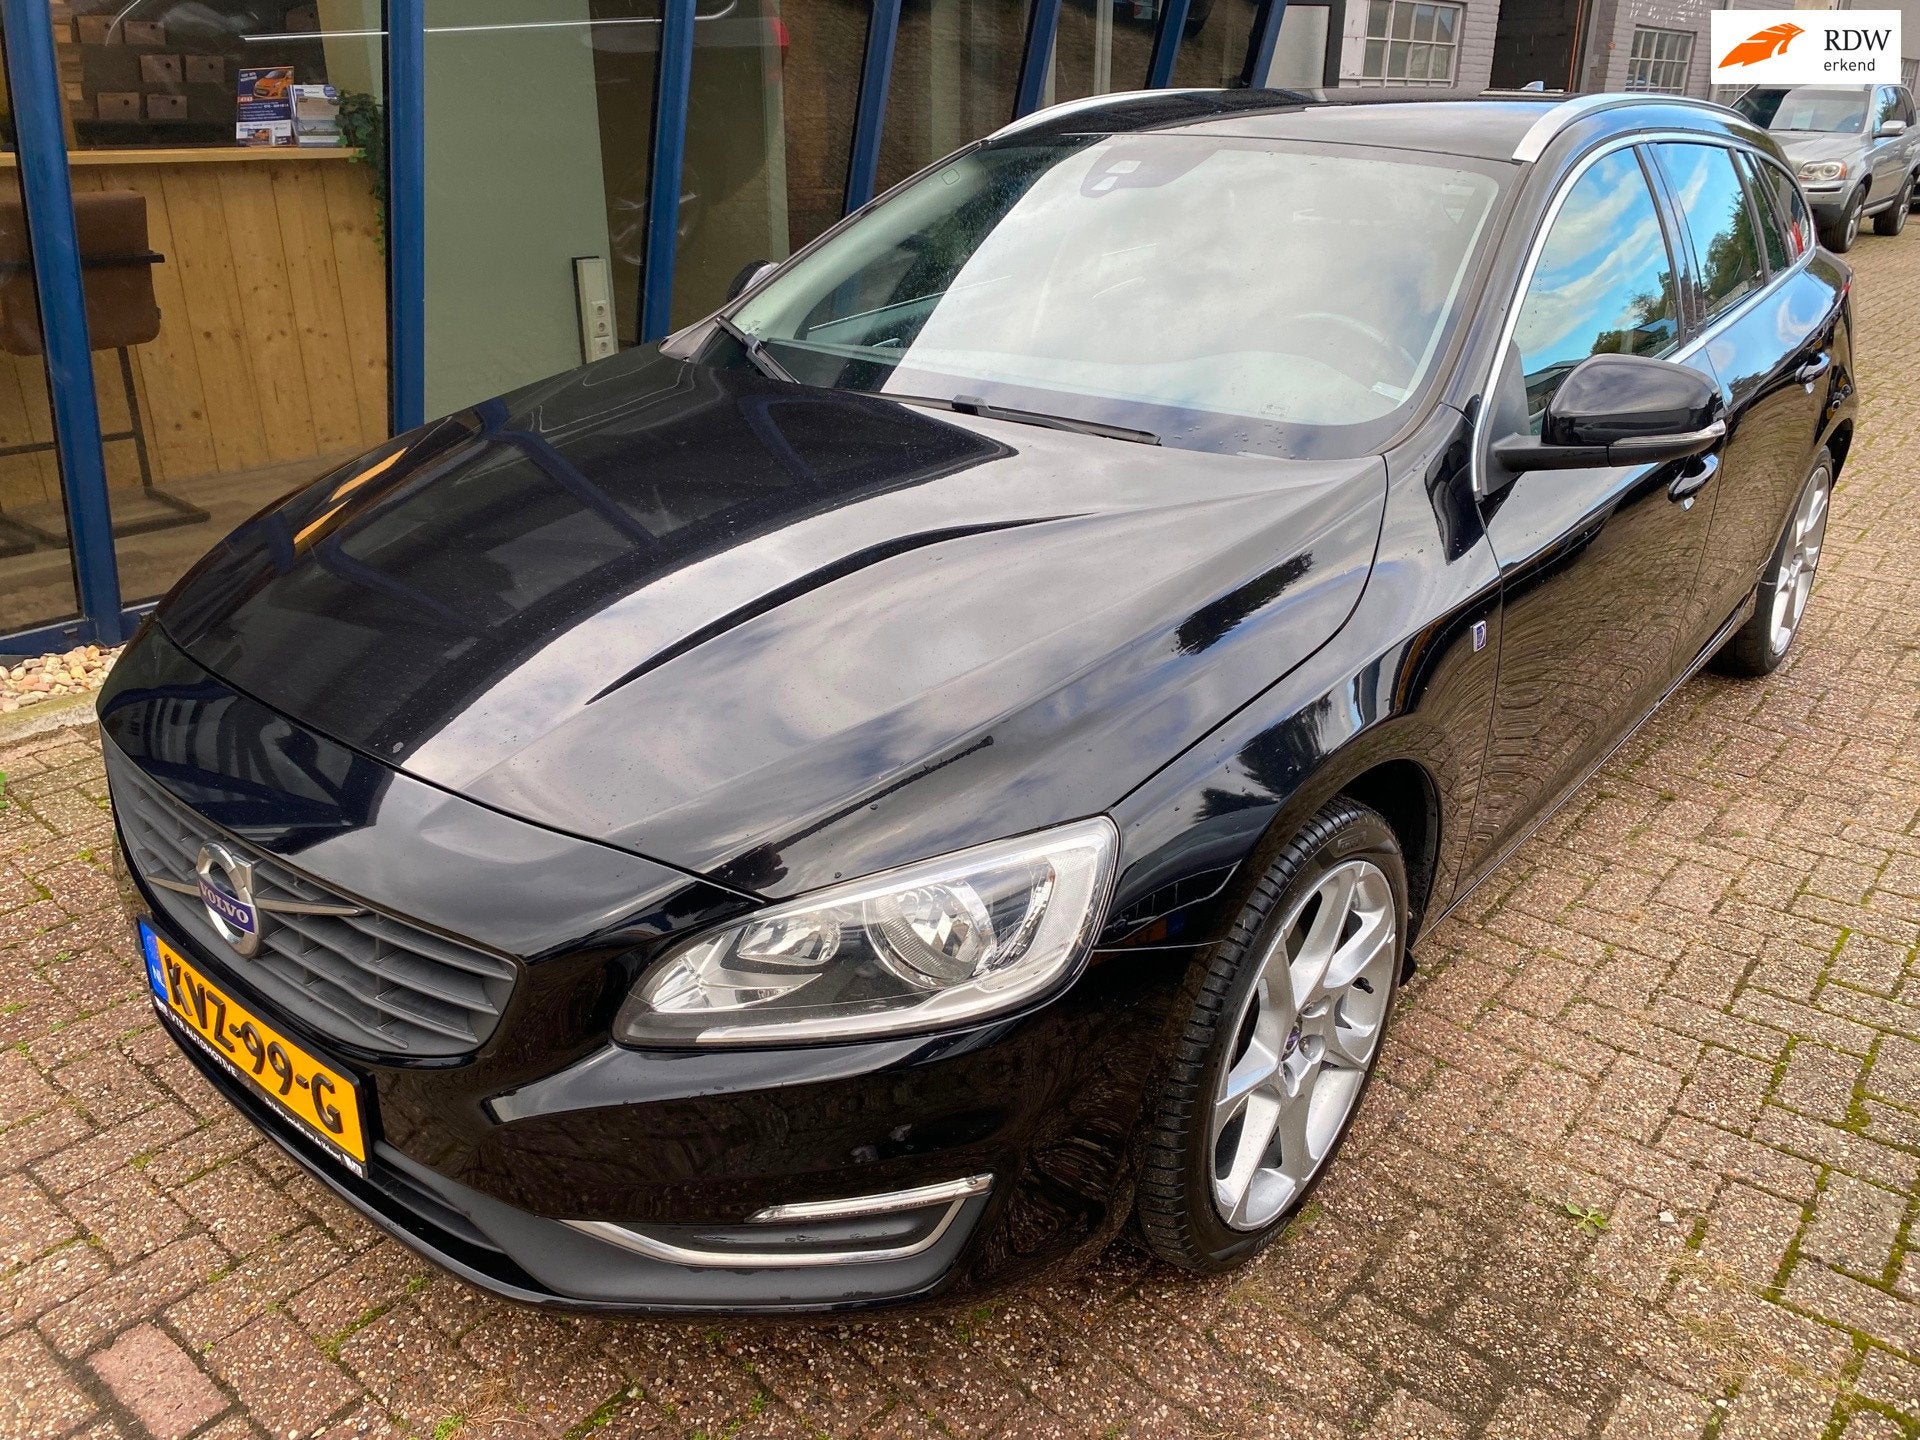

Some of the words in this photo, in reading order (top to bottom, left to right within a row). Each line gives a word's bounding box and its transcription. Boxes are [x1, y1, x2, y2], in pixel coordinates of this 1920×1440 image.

[199, 878, 250, 924] VOLVO
[164, 953, 344, 1134] KVZ-99-G
[185, 1026, 238, 1078] AUTOMOTIVE
